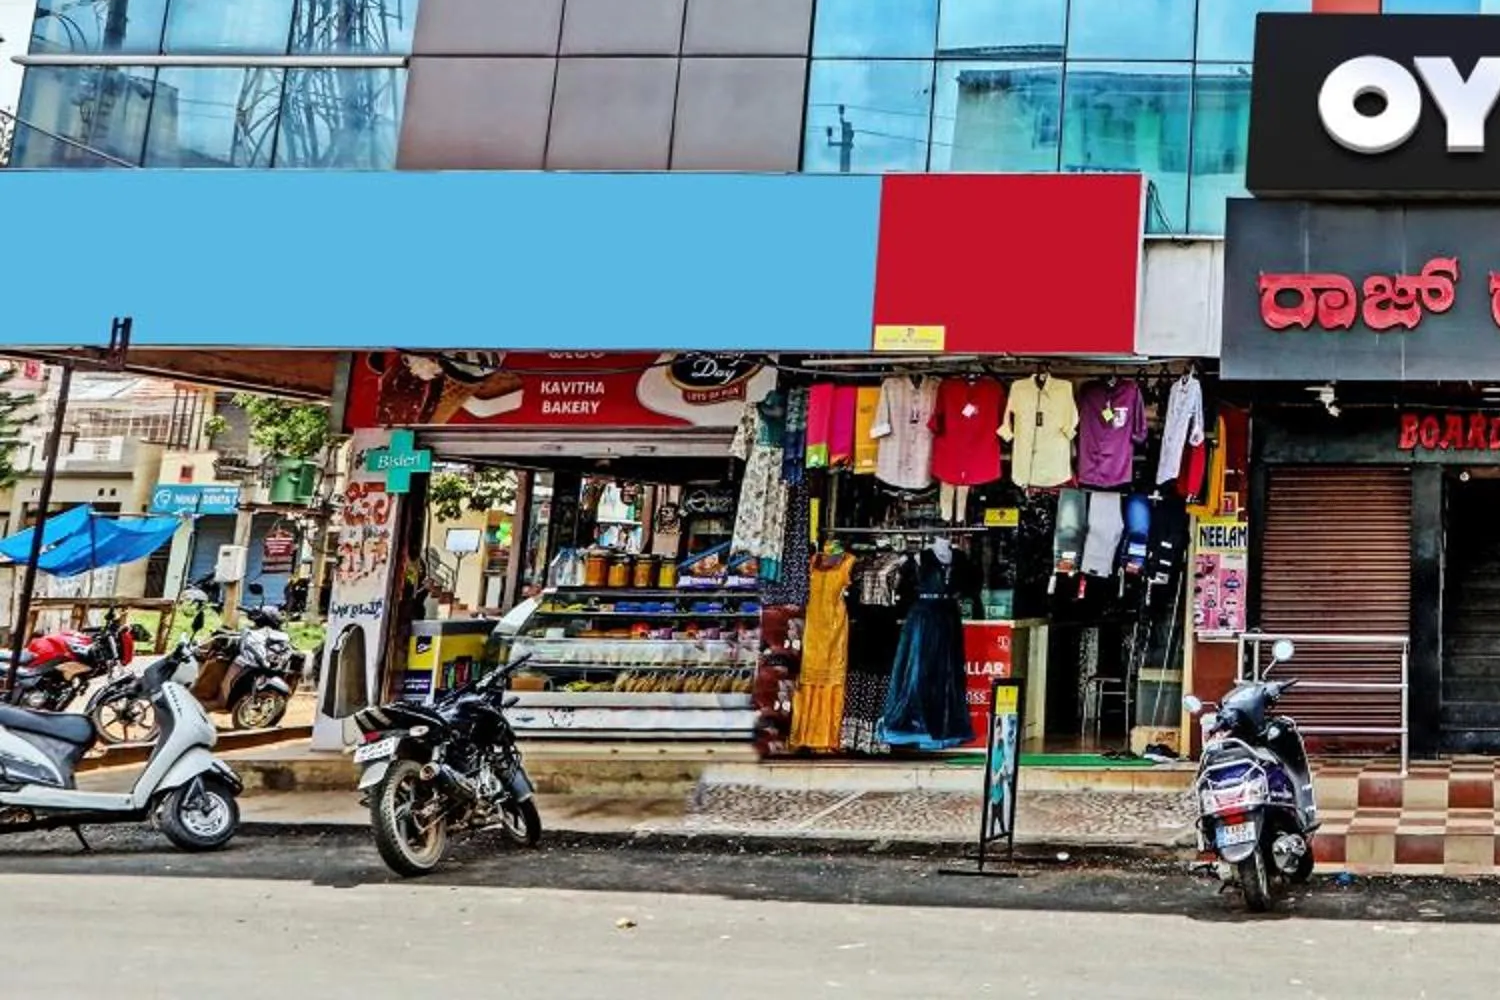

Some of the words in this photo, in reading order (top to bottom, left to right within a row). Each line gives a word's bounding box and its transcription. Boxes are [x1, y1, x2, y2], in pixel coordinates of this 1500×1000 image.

[1259, 256, 1460, 331] ರಾಜ್
[692, 360, 736, 384] Day
[541, 381, 605, 395] KAVITHA
[542, 401, 601, 415] BAKERY
[1200, 525, 1248, 548] NEELAM
